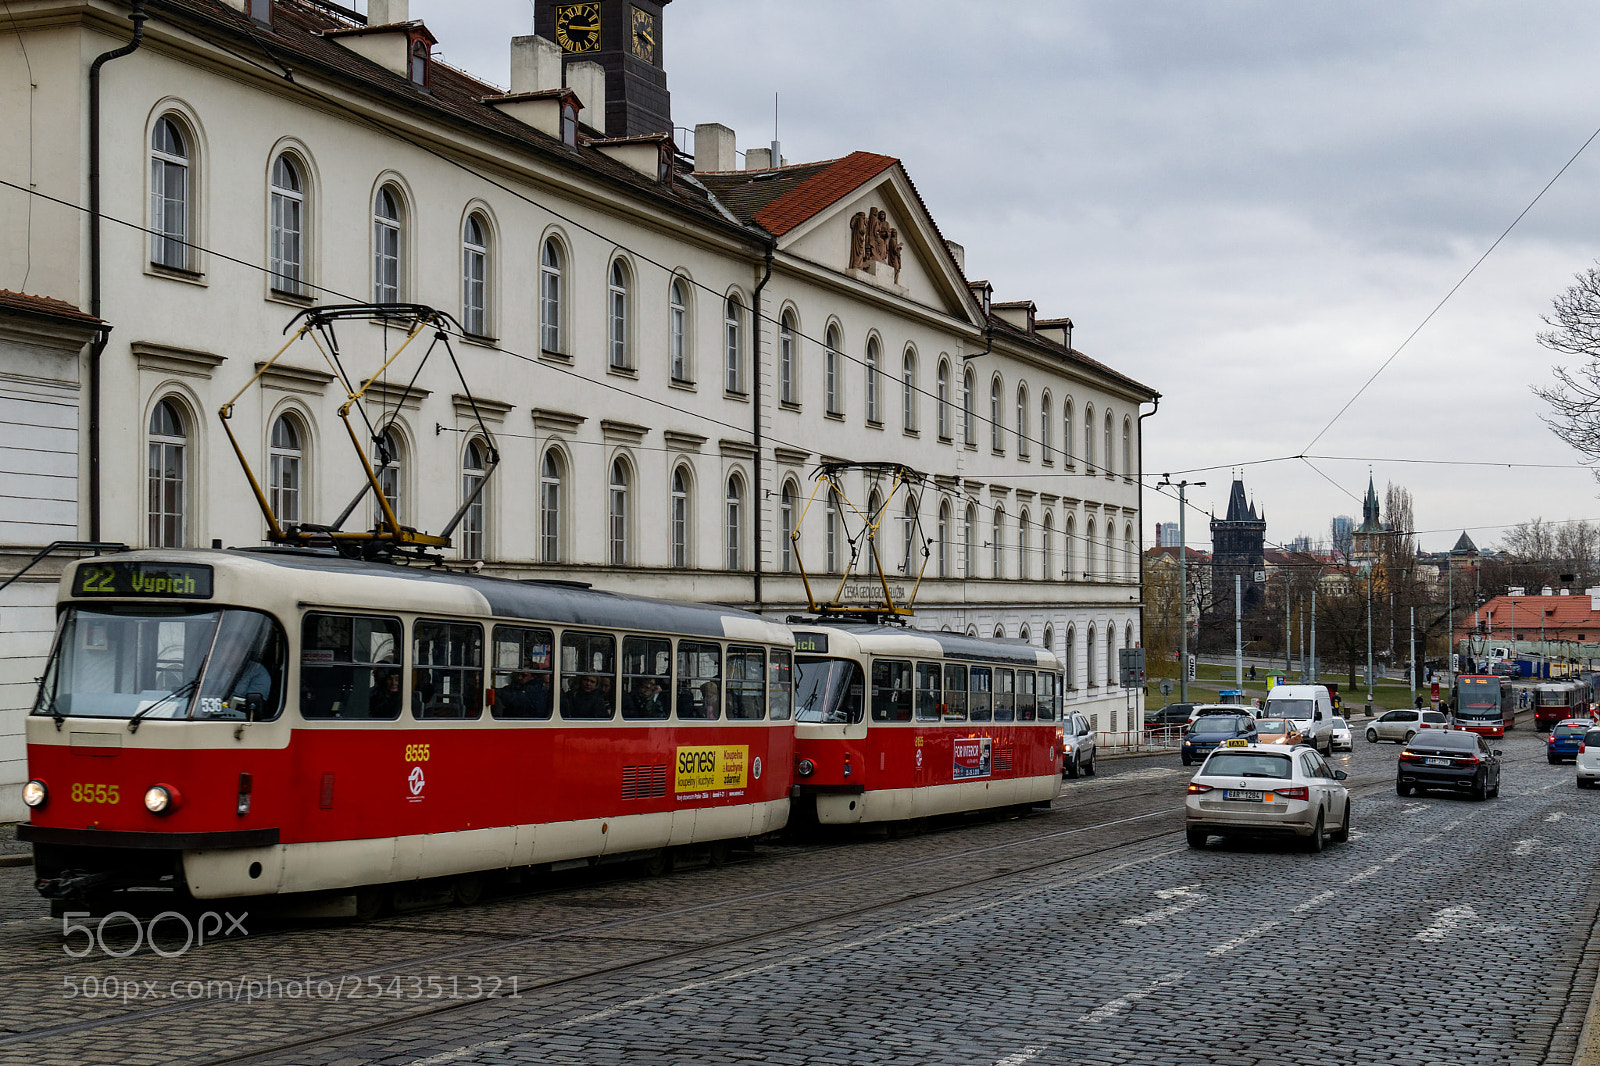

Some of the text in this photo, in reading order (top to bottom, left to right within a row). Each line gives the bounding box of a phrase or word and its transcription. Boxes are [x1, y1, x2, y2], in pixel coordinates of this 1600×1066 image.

[82, 566, 195, 594] 22 Vypich
[405, 744, 430, 762] 8555
[678, 751, 716, 774] senesi
[71, 783, 120, 804] 8555
